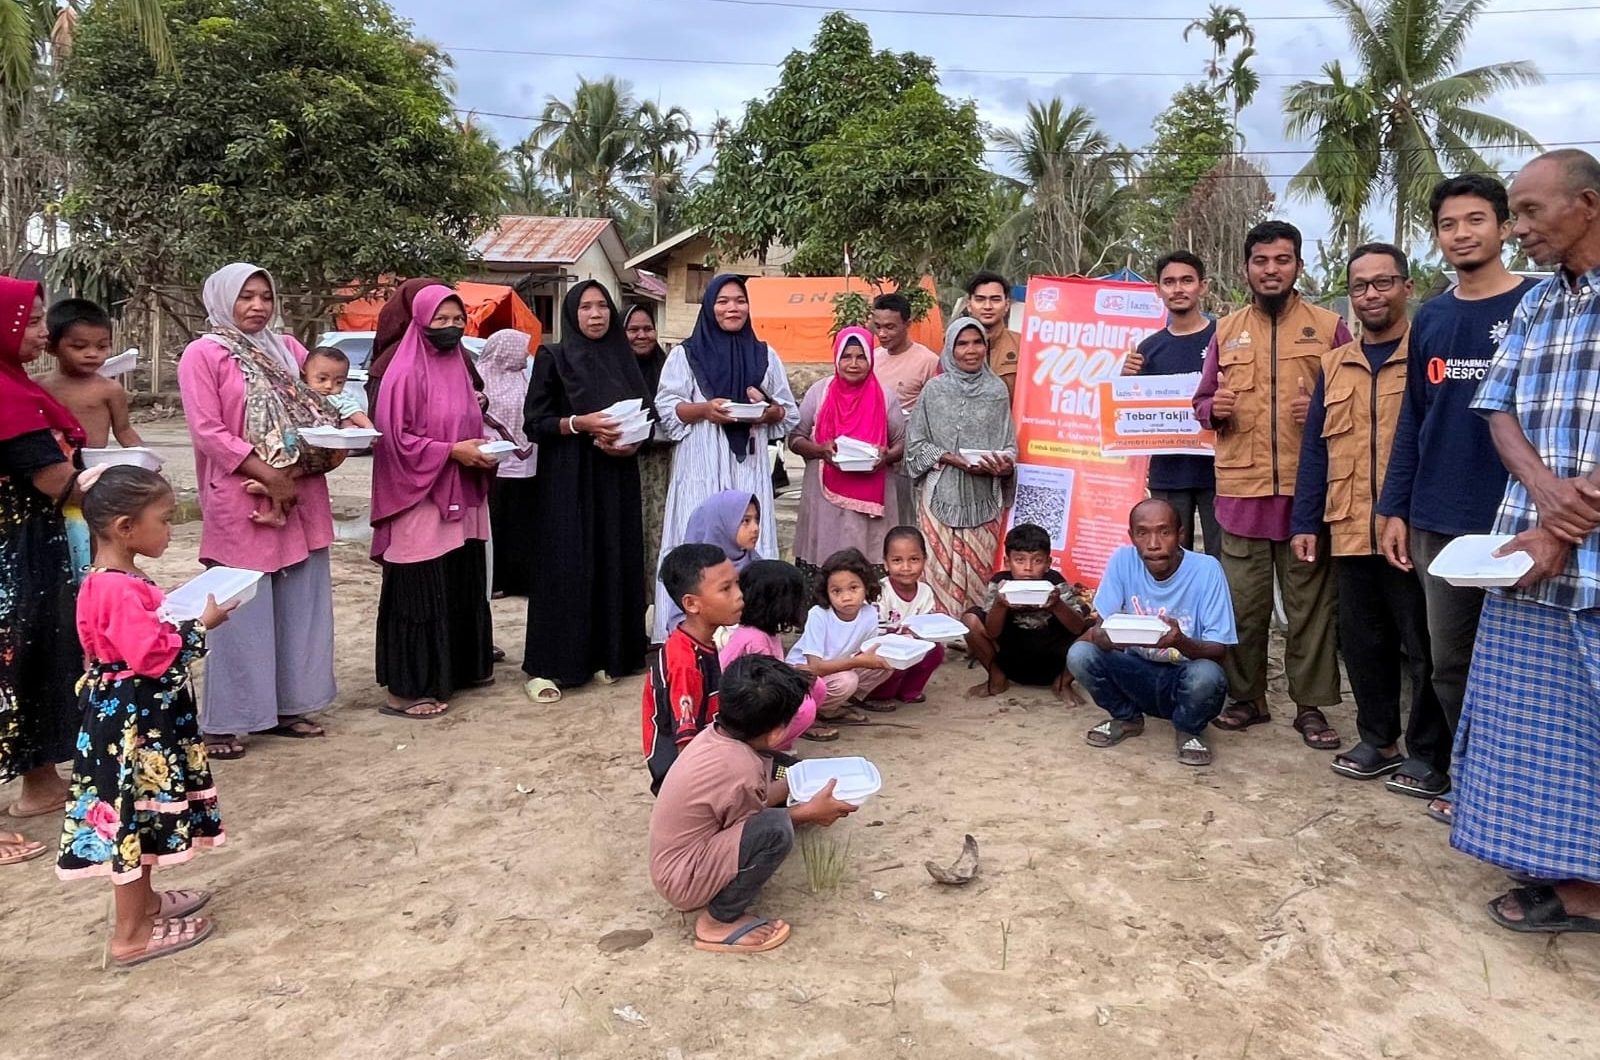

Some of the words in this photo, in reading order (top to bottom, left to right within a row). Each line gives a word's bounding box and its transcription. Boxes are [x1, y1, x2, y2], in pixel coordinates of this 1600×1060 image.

[1443, 367, 1487, 380] RESPO
[1050, 384, 1100, 419] Takj
[1126, 412, 1157, 420] Tebar
[1160, 410, 1189, 422] Takjil
